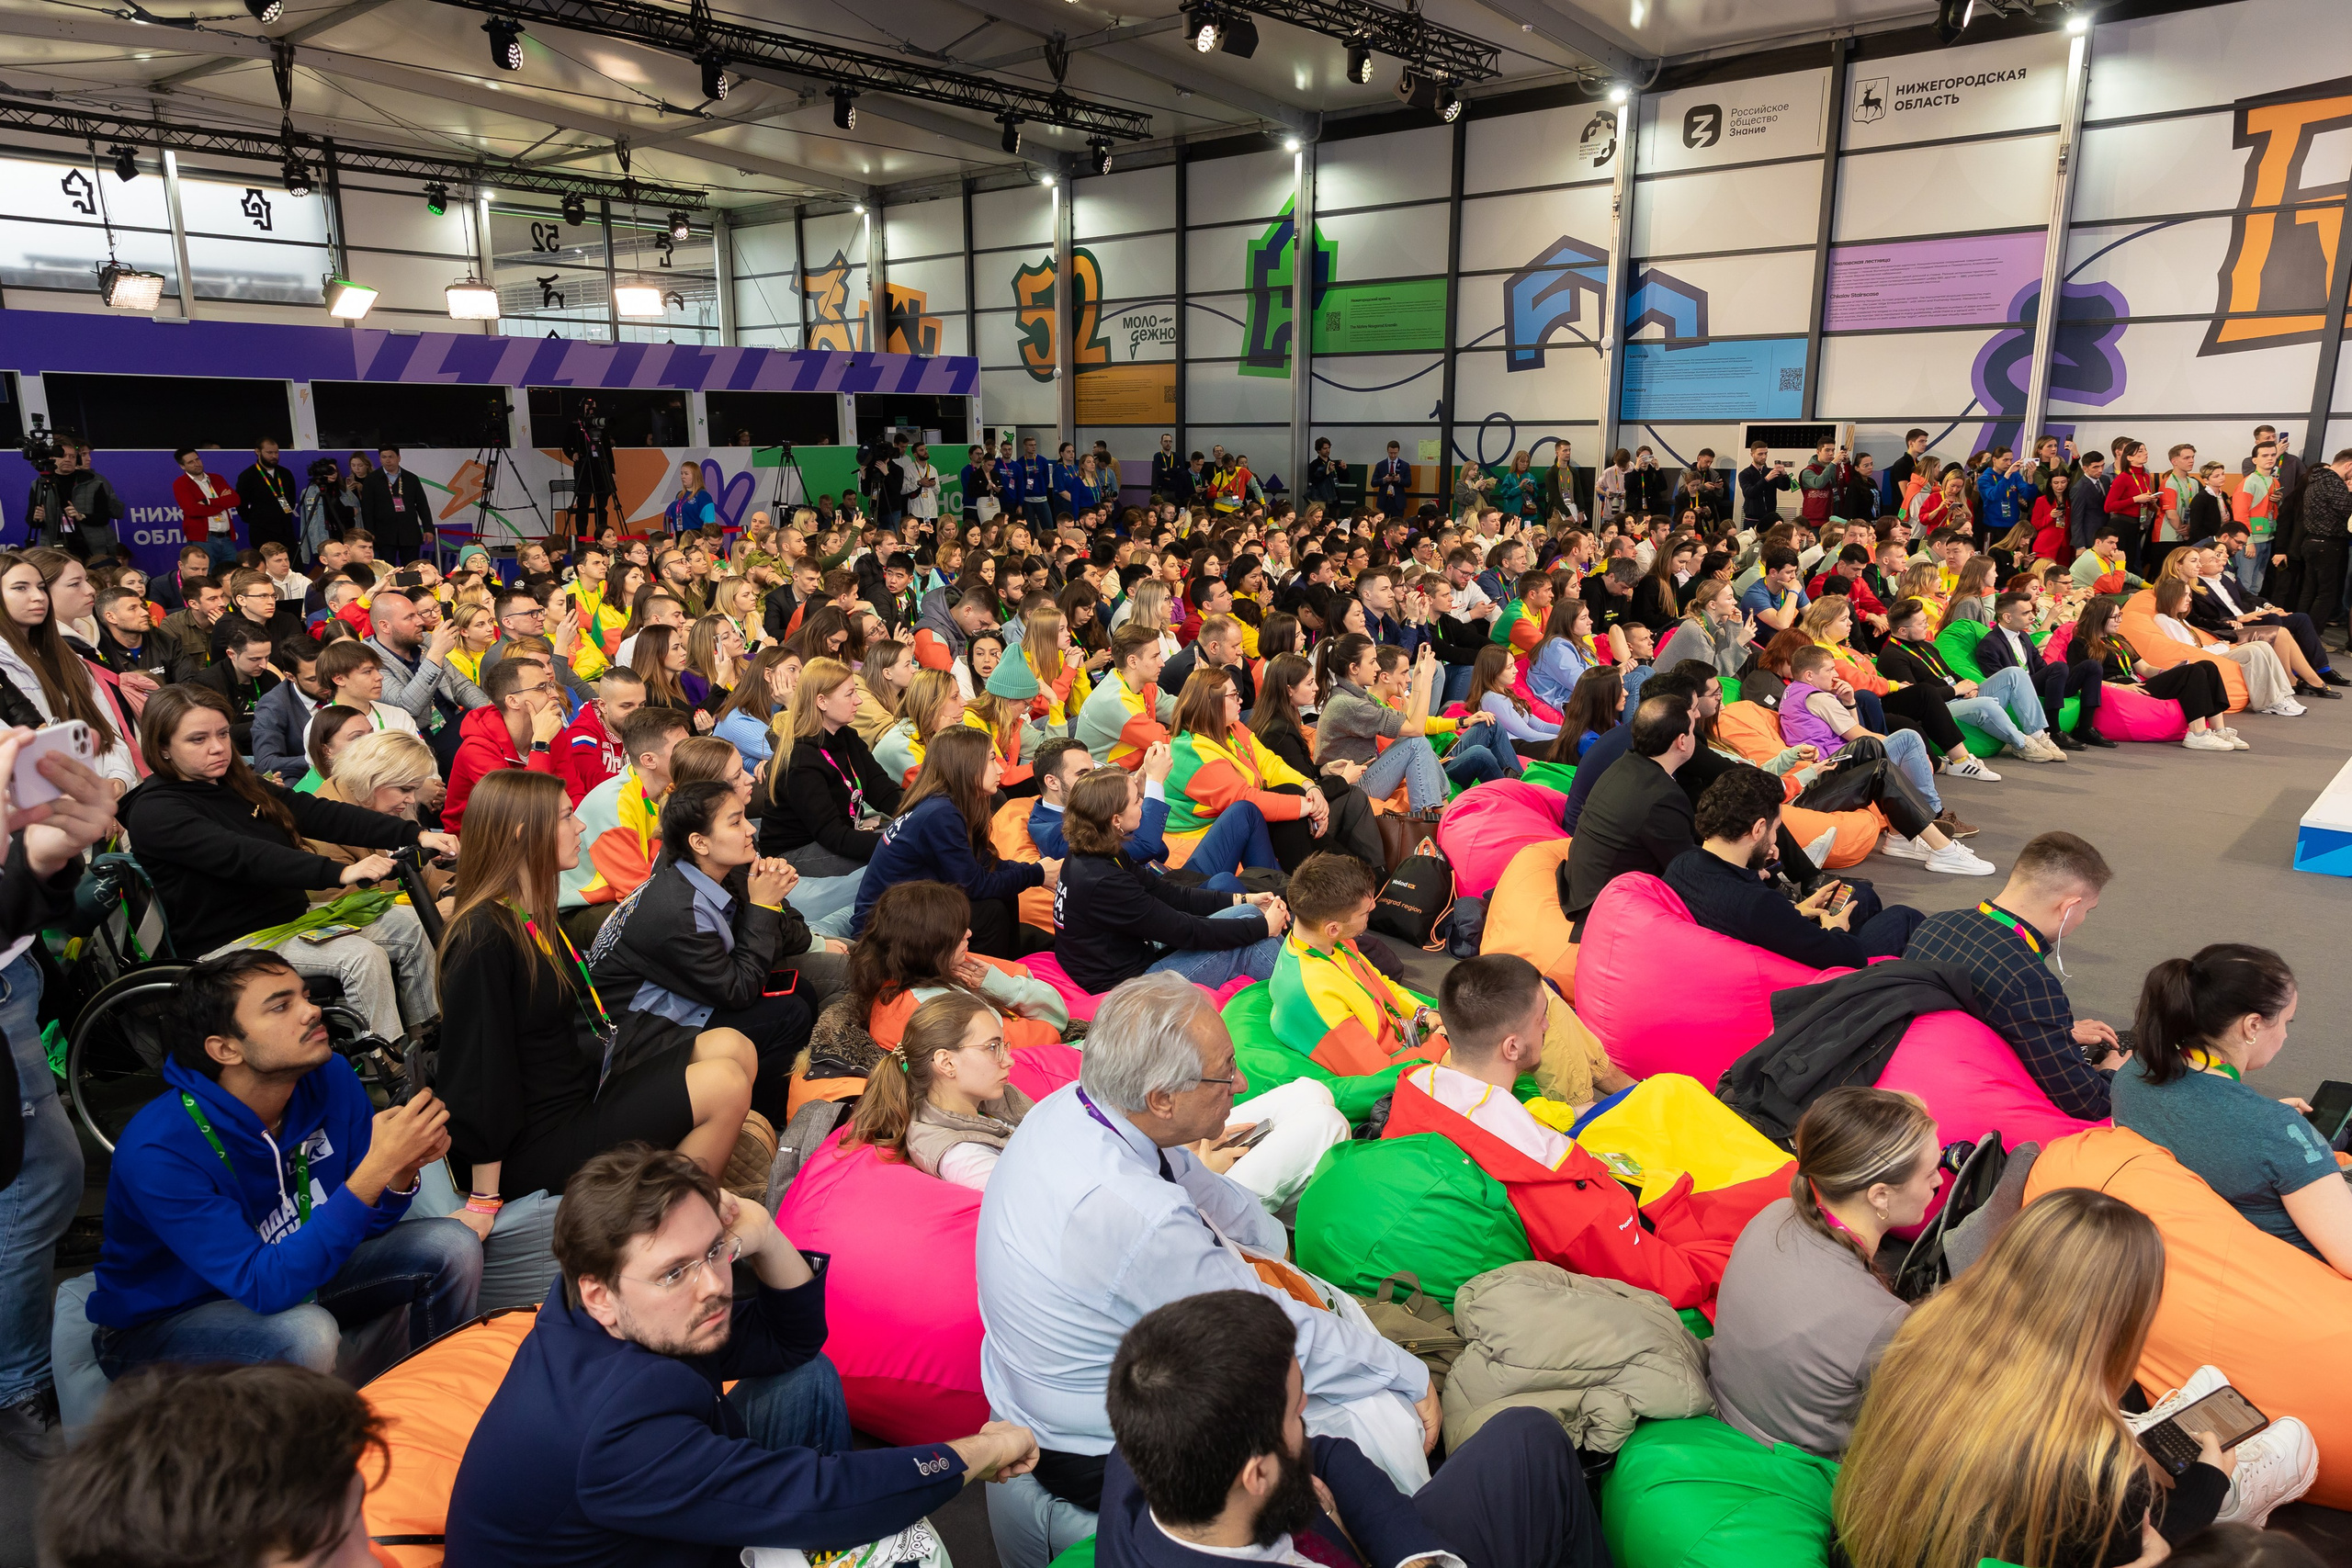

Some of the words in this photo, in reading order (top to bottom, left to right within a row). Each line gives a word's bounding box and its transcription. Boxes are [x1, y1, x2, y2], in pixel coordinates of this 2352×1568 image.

[1895, 68, 2027, 96] НИЖЕГОРОДСКАЯ
[1730, 102, 1790, 118] Российское
[1894, 94, 1960, 111] ОБЛАСТЬ
[1729, 114, 1779, 128] общество
[1729, 125, 1767, 137] Знание
[1401, 903, 1422, 914] region
